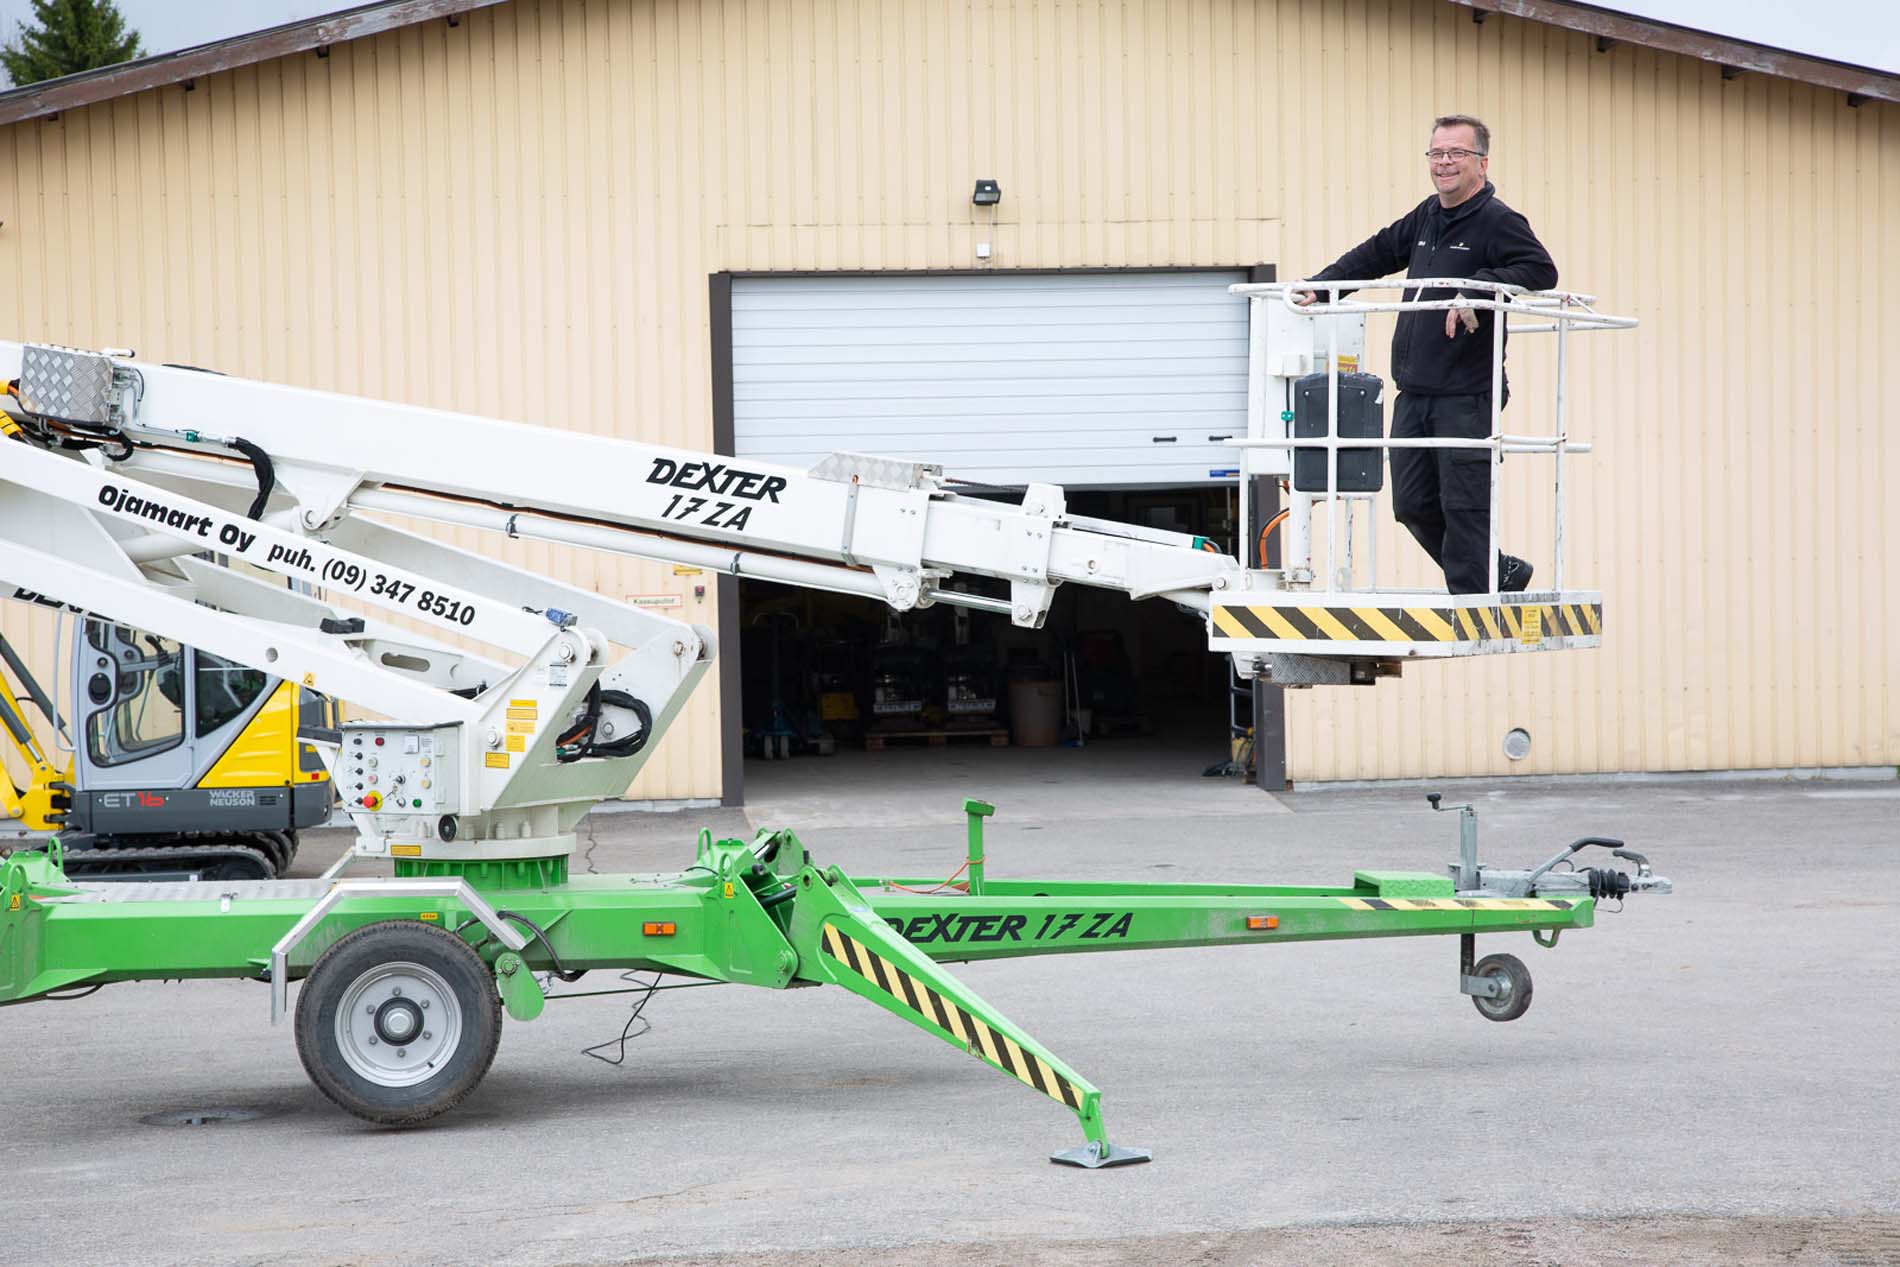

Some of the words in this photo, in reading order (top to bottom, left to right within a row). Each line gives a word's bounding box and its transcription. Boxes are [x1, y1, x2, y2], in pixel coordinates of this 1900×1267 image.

[646, 458, 787, 504] DEXTER
[661, 494, 708, 519] 17
[700, 502, 752, 531] ZA
[98, 484, 213, 537] Ojamart
[219, 523, 256, 552] Oy
[267, 543, 315, 572] puh.
[322, 558, 367, 592] (09)
[370, 574, 415, 603] 347
[417, 590, 475, 625] 8510
[209, 790, 255, 799] WACKER
[209, 798, 255, 807] NEUSON
[1035, 913, 1091, 940] 17
[1078, 912, 1133, 938] ZA
